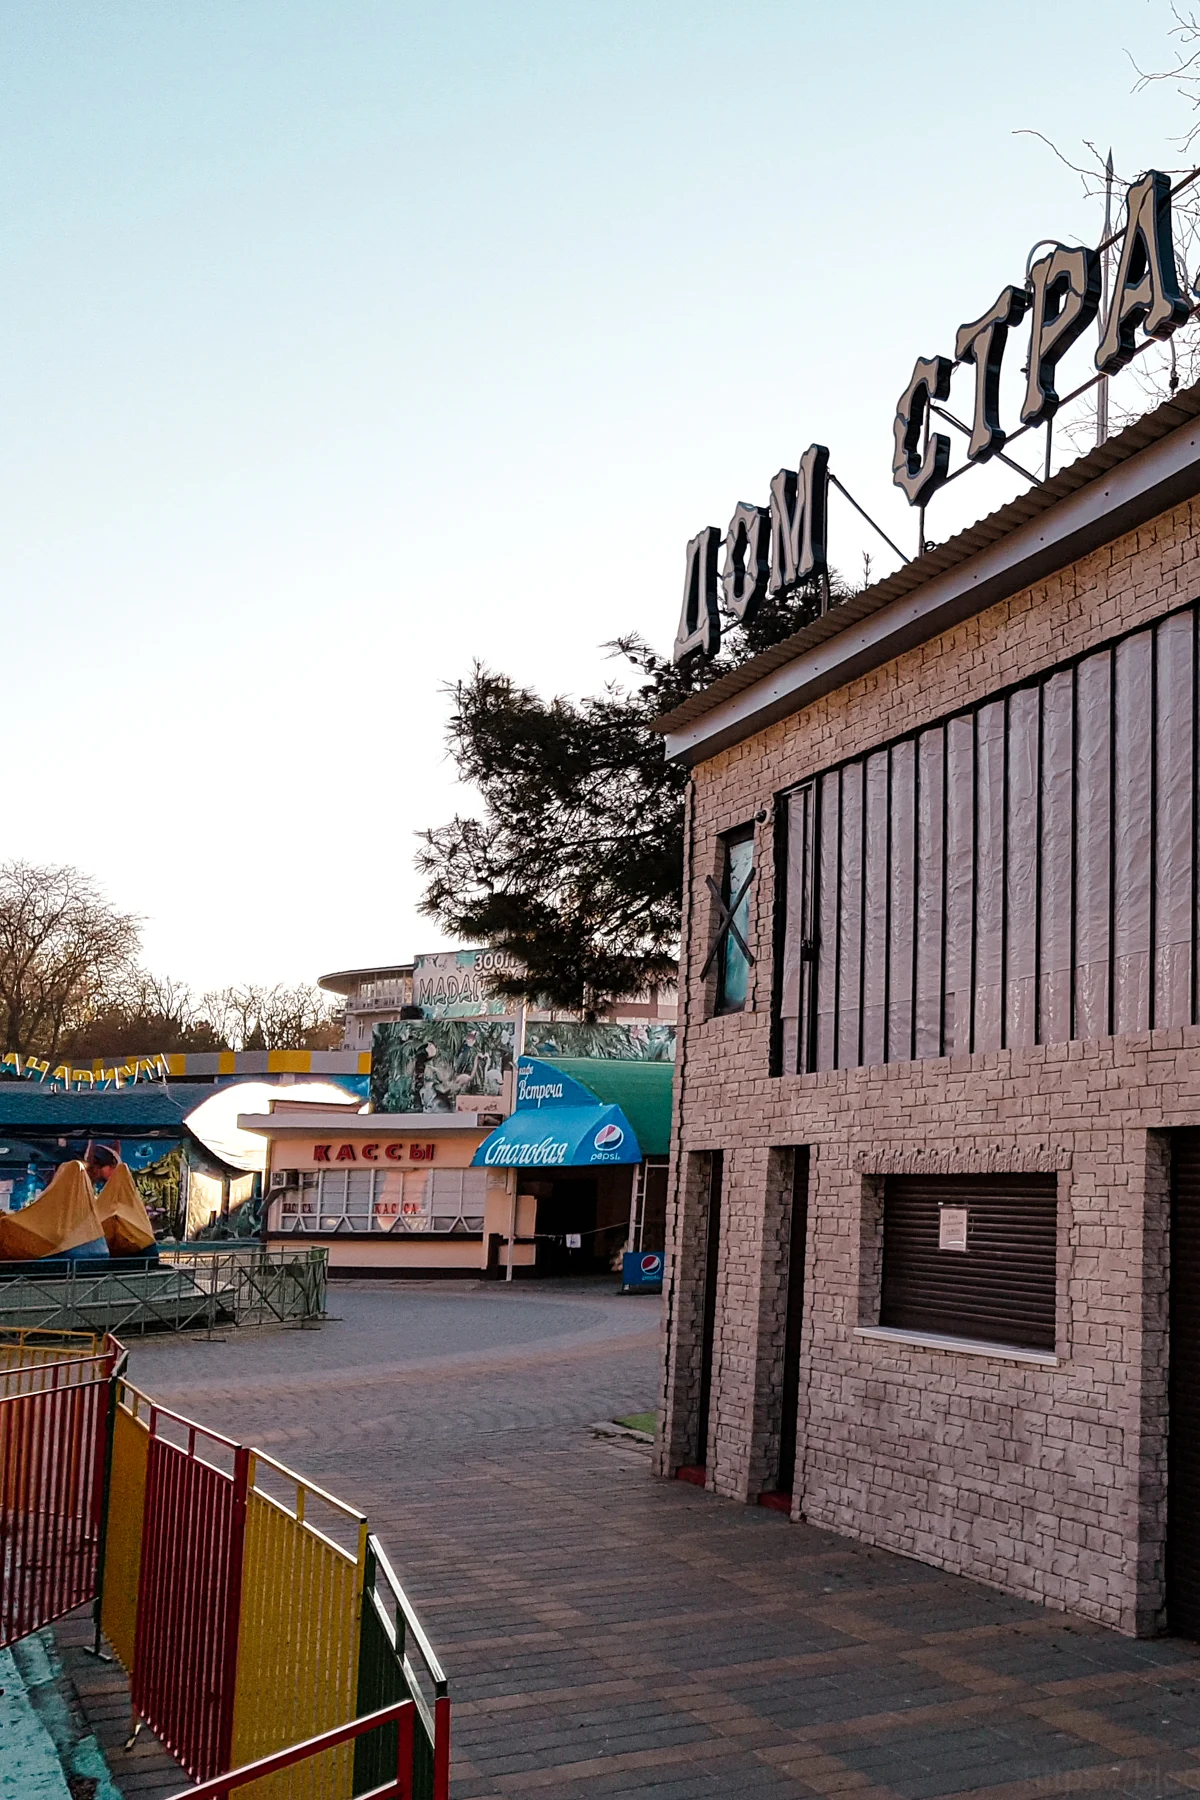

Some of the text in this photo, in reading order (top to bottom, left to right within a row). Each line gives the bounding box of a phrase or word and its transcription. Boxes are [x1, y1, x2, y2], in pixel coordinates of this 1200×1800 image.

[674, 443, 830, 667] ДОМ
[518, 1080, 563, 1108] Встреча
[313, 1143, 436, 1162] КАССЫ
[484, 1137, 569, 1165] Столовая
